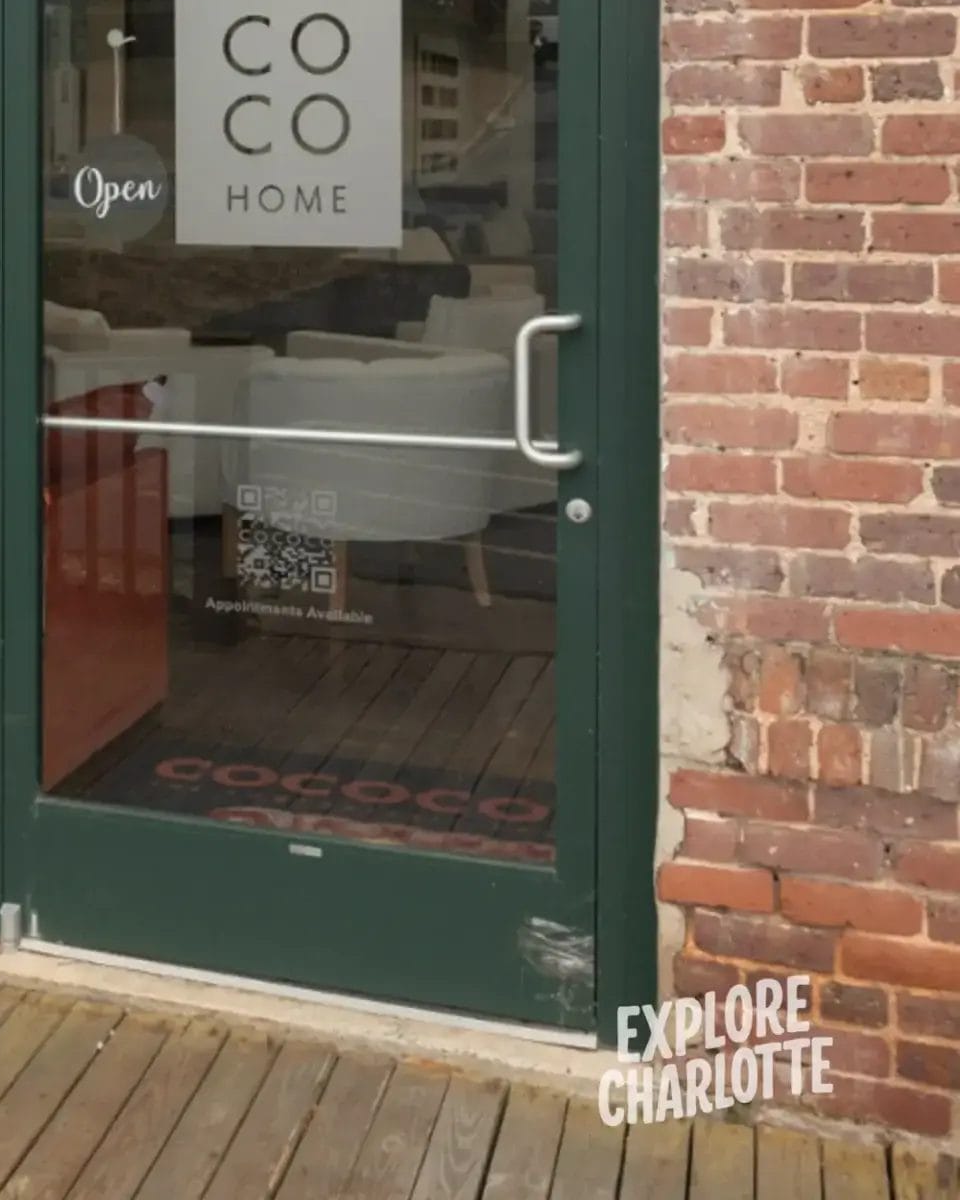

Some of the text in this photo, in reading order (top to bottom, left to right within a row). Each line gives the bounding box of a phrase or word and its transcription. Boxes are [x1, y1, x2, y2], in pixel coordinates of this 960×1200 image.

[222, 13, 351, 76] CO
[223, 93, 351, 156] CO
[74, 165, 162, 219] Open
[227, 184, 347, 214] HOME
[205, 597, 374, 625] Appointments Available
